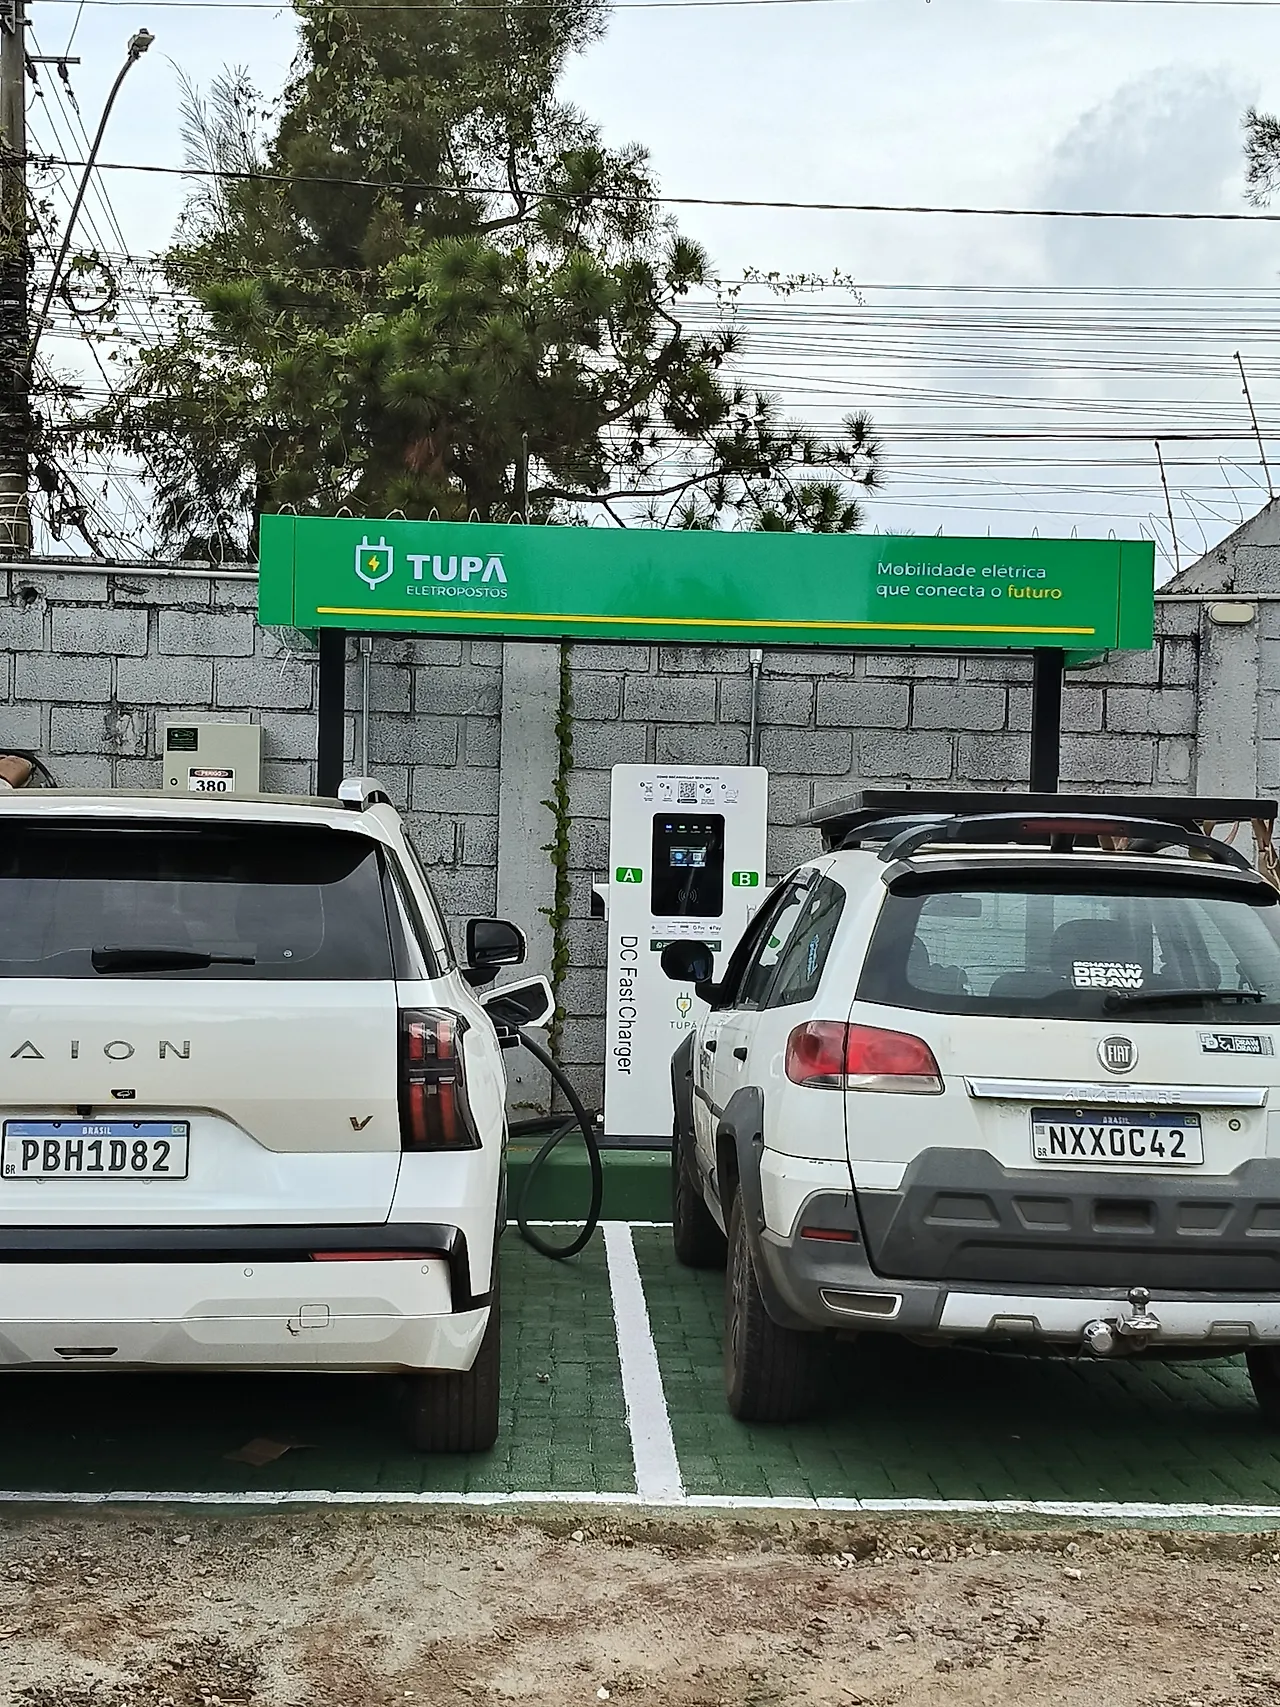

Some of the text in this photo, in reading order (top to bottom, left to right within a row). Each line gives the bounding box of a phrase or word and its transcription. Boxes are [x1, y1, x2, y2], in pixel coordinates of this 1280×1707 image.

[877, 562, 1046, 579] Mobilidade elétrica
[406, 585, 508, 598] ELETROPOSTOS
[876, 583, 1063, 600] que conecta o futuro
[196, 780, 227, 792] 380
[623, 869, 636, 882] A
[739, 873, 751, 886] B
[1073, 967, 1143, 979] DRAW
[1074, 976, 1144, 988] DRAW
[613, 936, 638, 1075] DC Fast Charger
[10, 1040, 191, 1060] AION
[1107, 1044, 1131, 1063] FIAT
[1062, 1088, 1182, 1104] ADVENTURE
[349, 1115, 374, 1131] V
[82, 1126, 112, 1136] BRASIL
[22, 1139, 171, 1172] PBH1D82
[5, 1164, 16, 1175] BR
